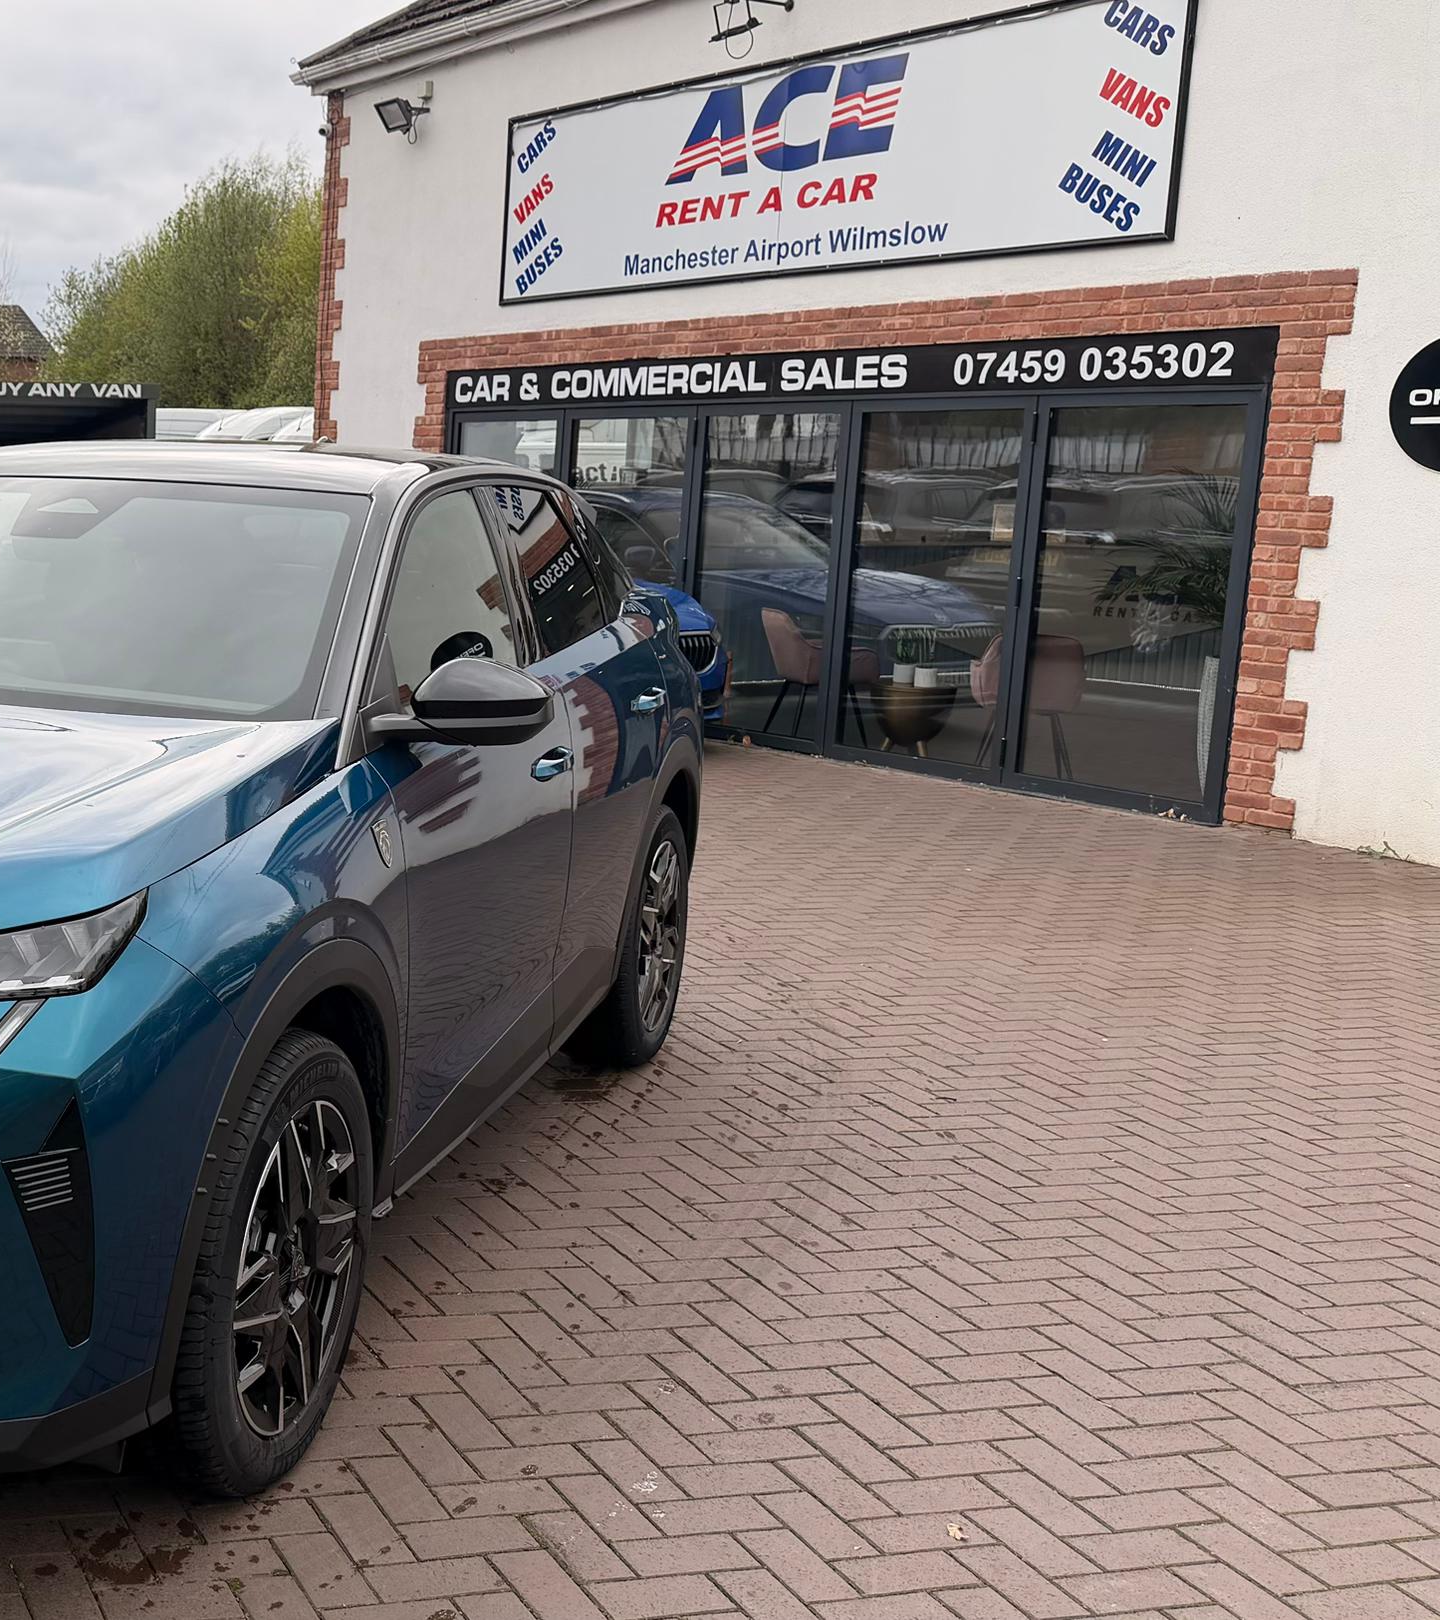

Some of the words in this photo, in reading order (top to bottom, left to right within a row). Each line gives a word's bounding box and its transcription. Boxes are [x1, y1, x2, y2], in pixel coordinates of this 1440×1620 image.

[1103, 0, 1176, 56] CARS
[665, 52, 910, 186] ACE
[1099, 67, 1171, 128] VANS
[516, 120, 557, 174] CARS
[1091, 130, 1158, 188] MINI
[513, 173, 554, 225] VANS
[655, 190, 750, 228] RENT
[757, 186, 782, 215] A
[797, 173, 877, 209] CAR
[1058, 162, 1141, 232] BUSES
[512, 218, 548, 265] MINI
[515, 237, 563, 296] BUSES
[624, 245, 739, 276] Manchester
[744, 233, 822, 265] Airport
[828, 221, 948, 253] Wilmslow
[454, 374, 510, 403] CAR
[519, 373, 540, 401] &
[550, 361, 766, 401] COMMERCIAL
[780, 353, 908, 392] SALES
[953, 348, 1066, 386] 07459
[1079, 340, 1235, 382] 035302
[28, 383, 81, 398] ANY
[90, 383, 142, 399] VAN
